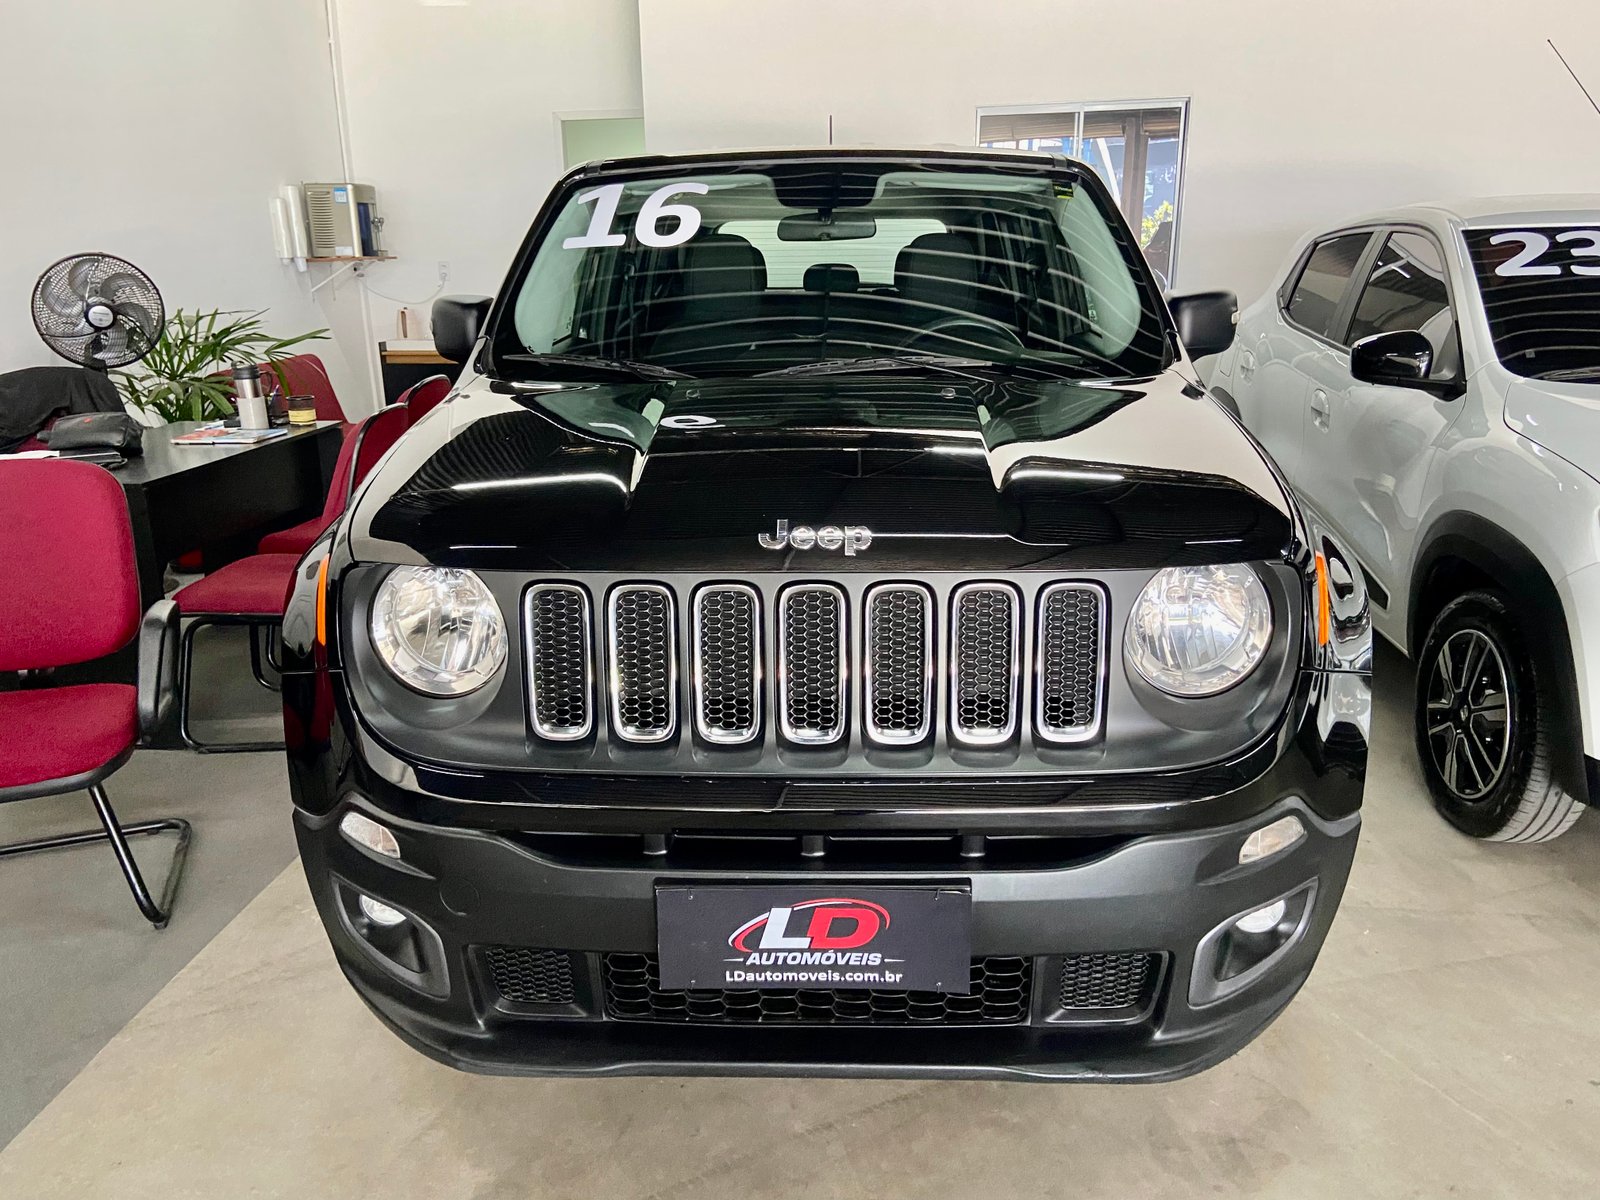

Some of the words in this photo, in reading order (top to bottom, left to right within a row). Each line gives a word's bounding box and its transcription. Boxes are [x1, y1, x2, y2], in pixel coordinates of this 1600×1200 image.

[562, 182, 709, 250] 16
[1489, 230, 1600, 276] 23
[758, 518, 873, 556] Jeep
[759, 907, 881, 949] LD
[725, 969, 903, 983] LDautomoveis.com.br
[745, 950, 882, 966] AUTOMÓVEIS
